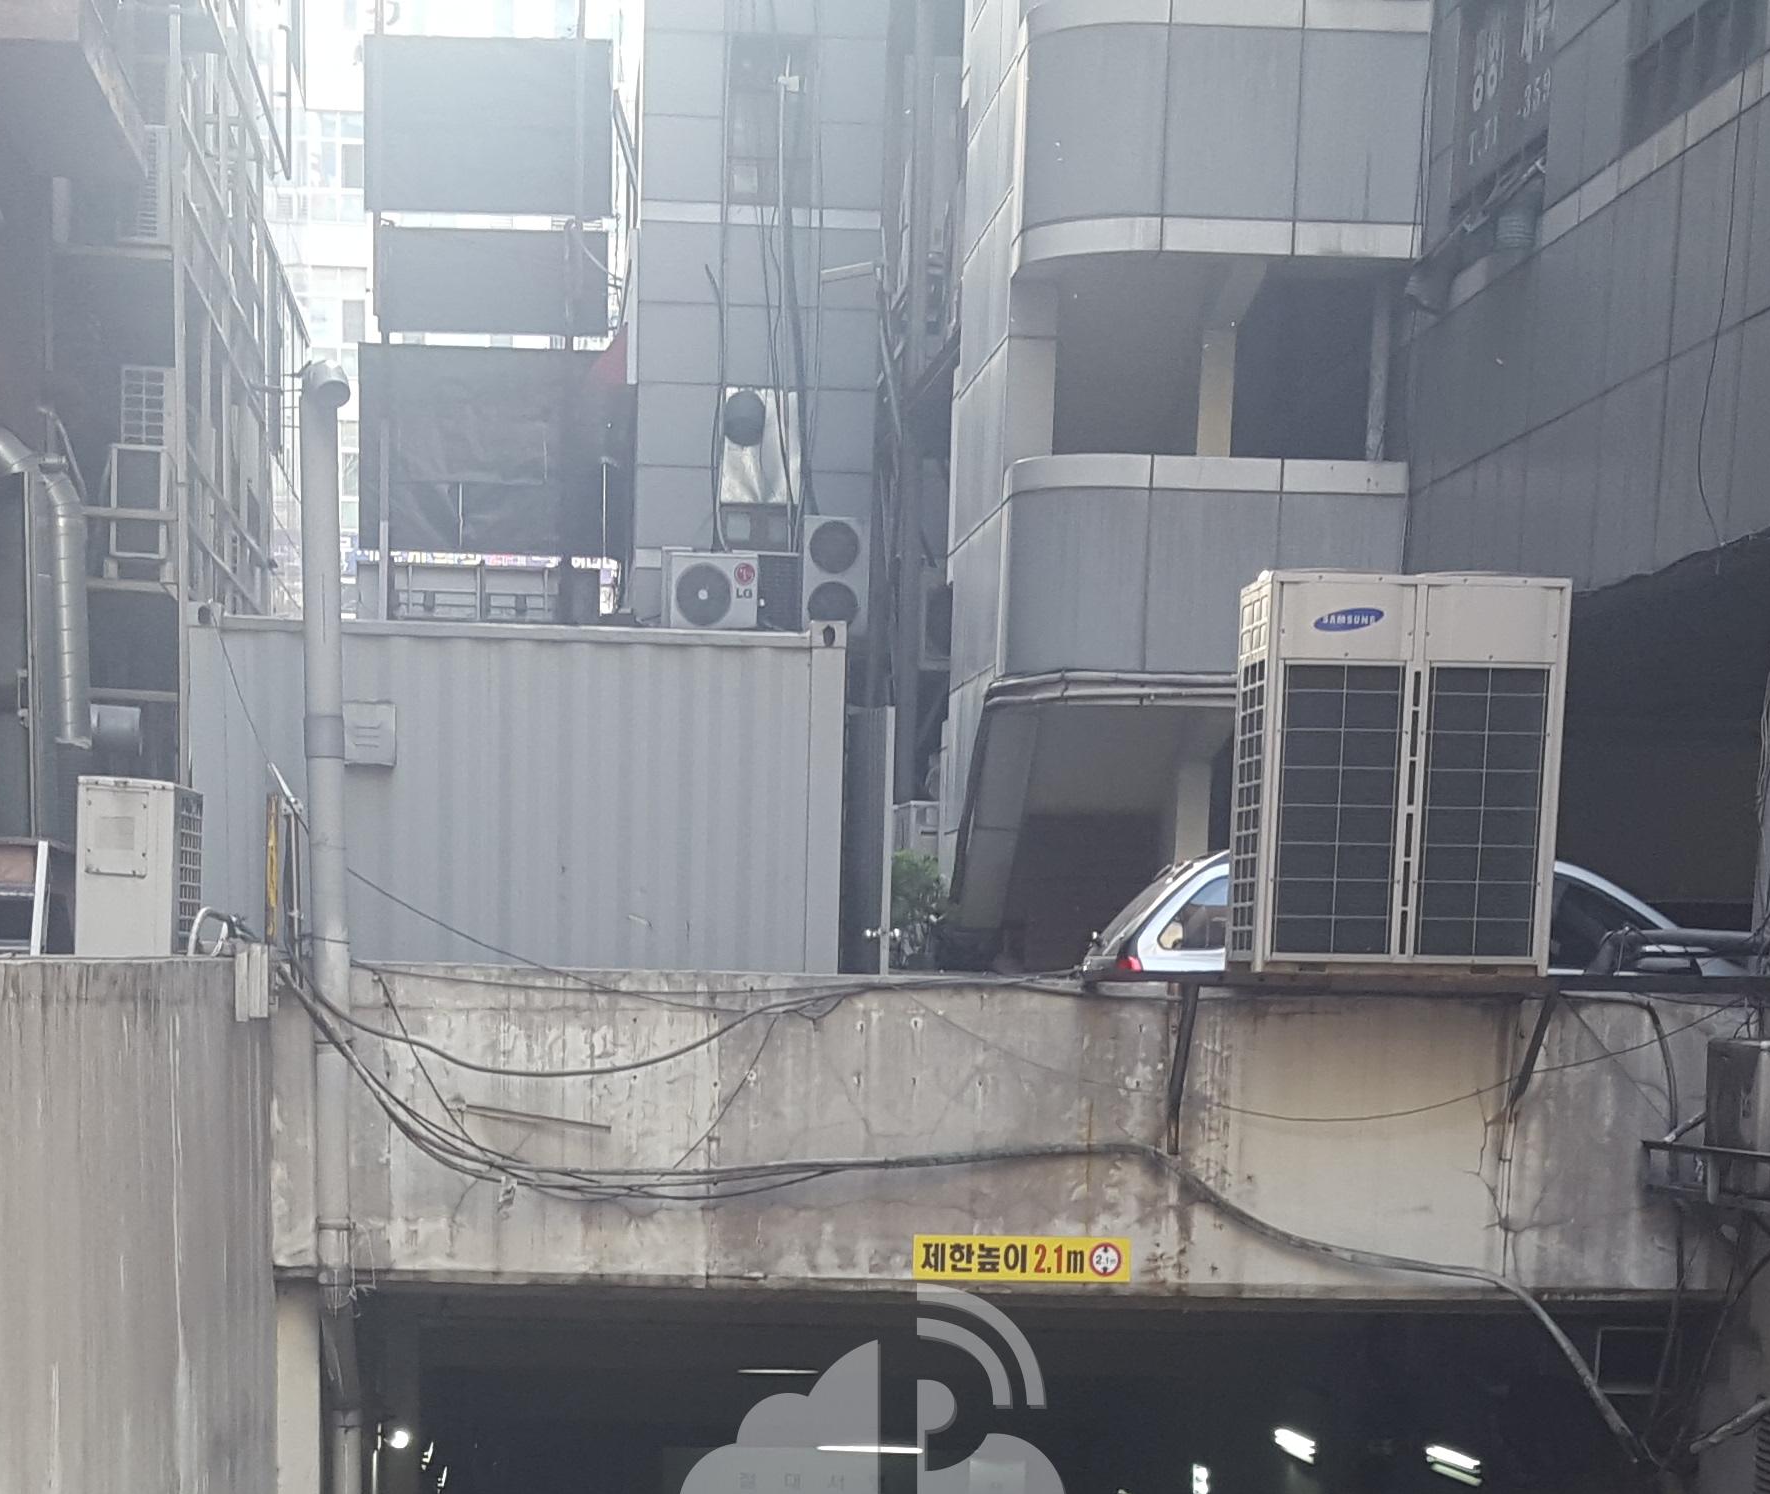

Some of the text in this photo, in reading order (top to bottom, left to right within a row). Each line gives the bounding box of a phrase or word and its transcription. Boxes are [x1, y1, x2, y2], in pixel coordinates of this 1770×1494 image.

[736, 588, 753, 599] LG
[1321, 613, 1377, 626] SAMSUNG
[920, 1242, 1085, 1274] 제한높이 2.1m
